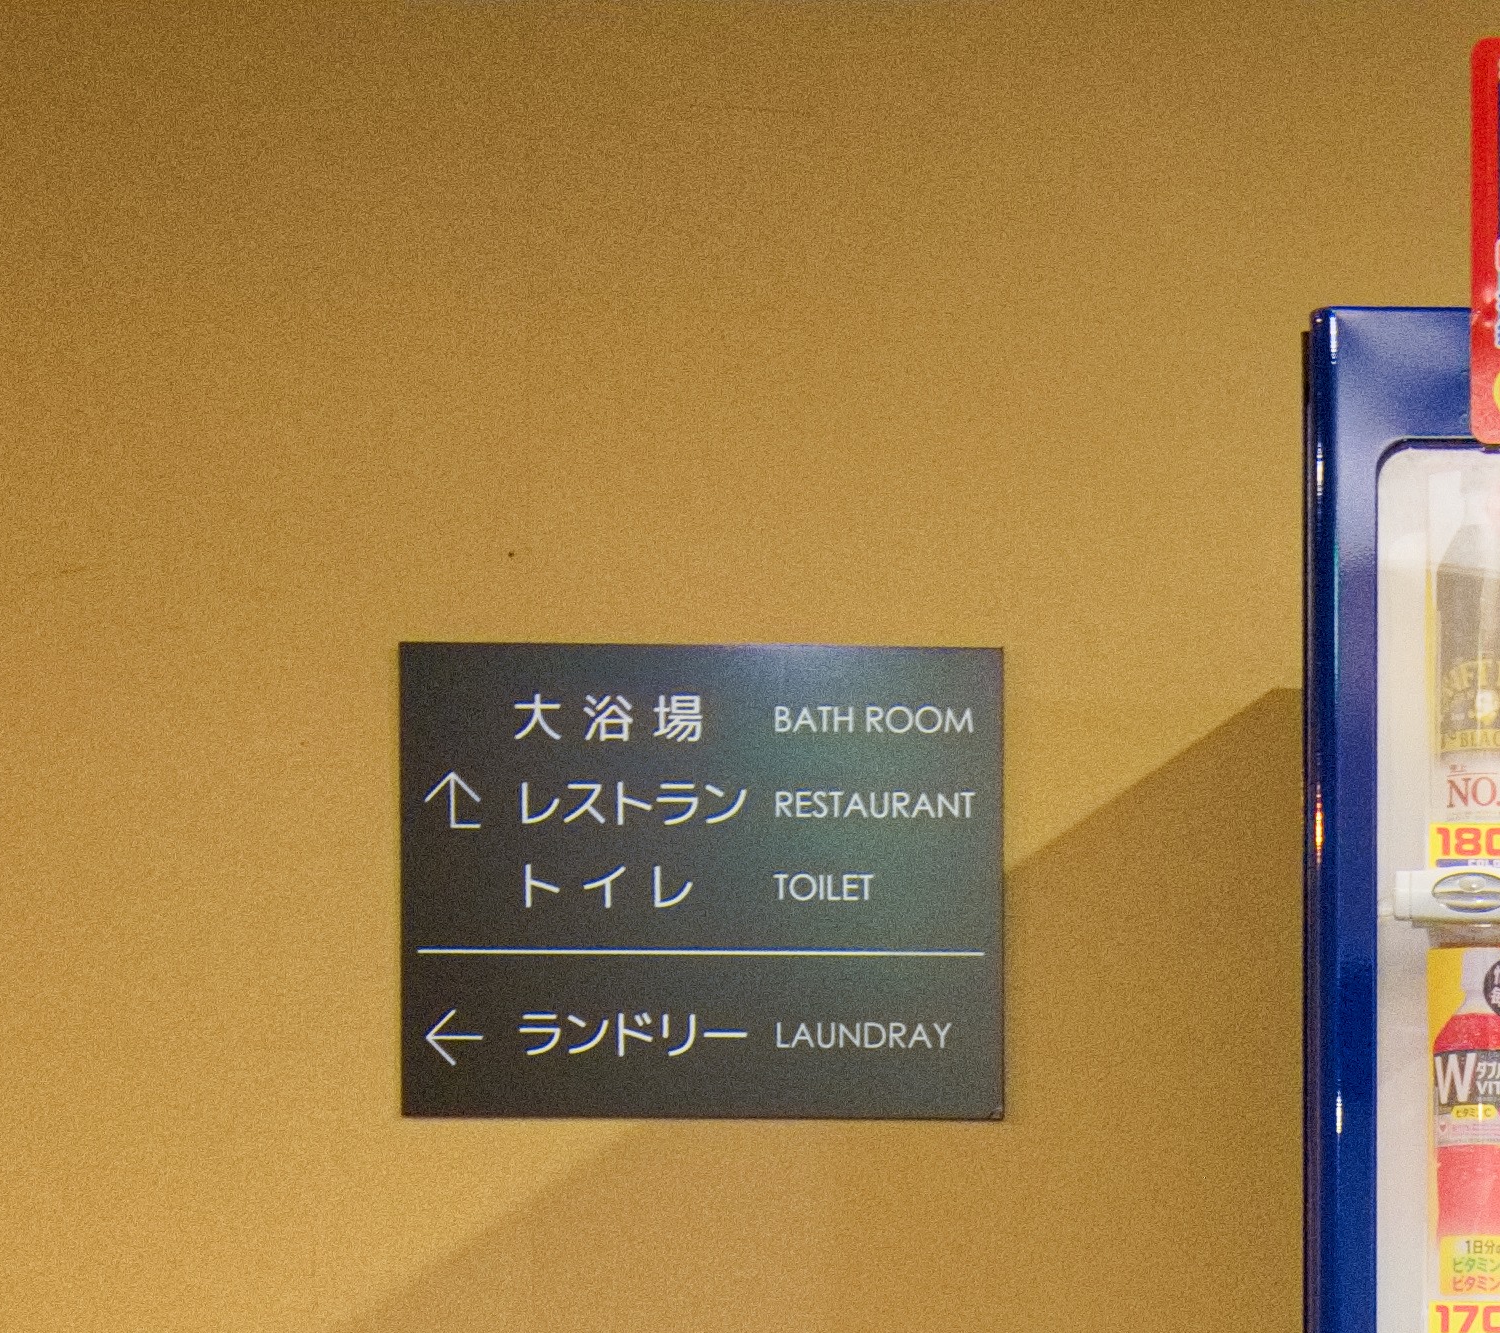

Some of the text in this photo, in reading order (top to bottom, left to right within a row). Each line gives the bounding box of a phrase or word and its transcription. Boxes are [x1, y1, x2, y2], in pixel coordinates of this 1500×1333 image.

[774, 705, 854, 733] BATH
[866, 705, 974, 734] ROOM
[520, 780, 975, 825] レストラン RESTAURANT
[524, 864, 874, 908] トイレ TOILET
[518, 1011, 953, 1057] ランドリー LAUNDRAY
[1435, 1053, 1477, 1105] W
